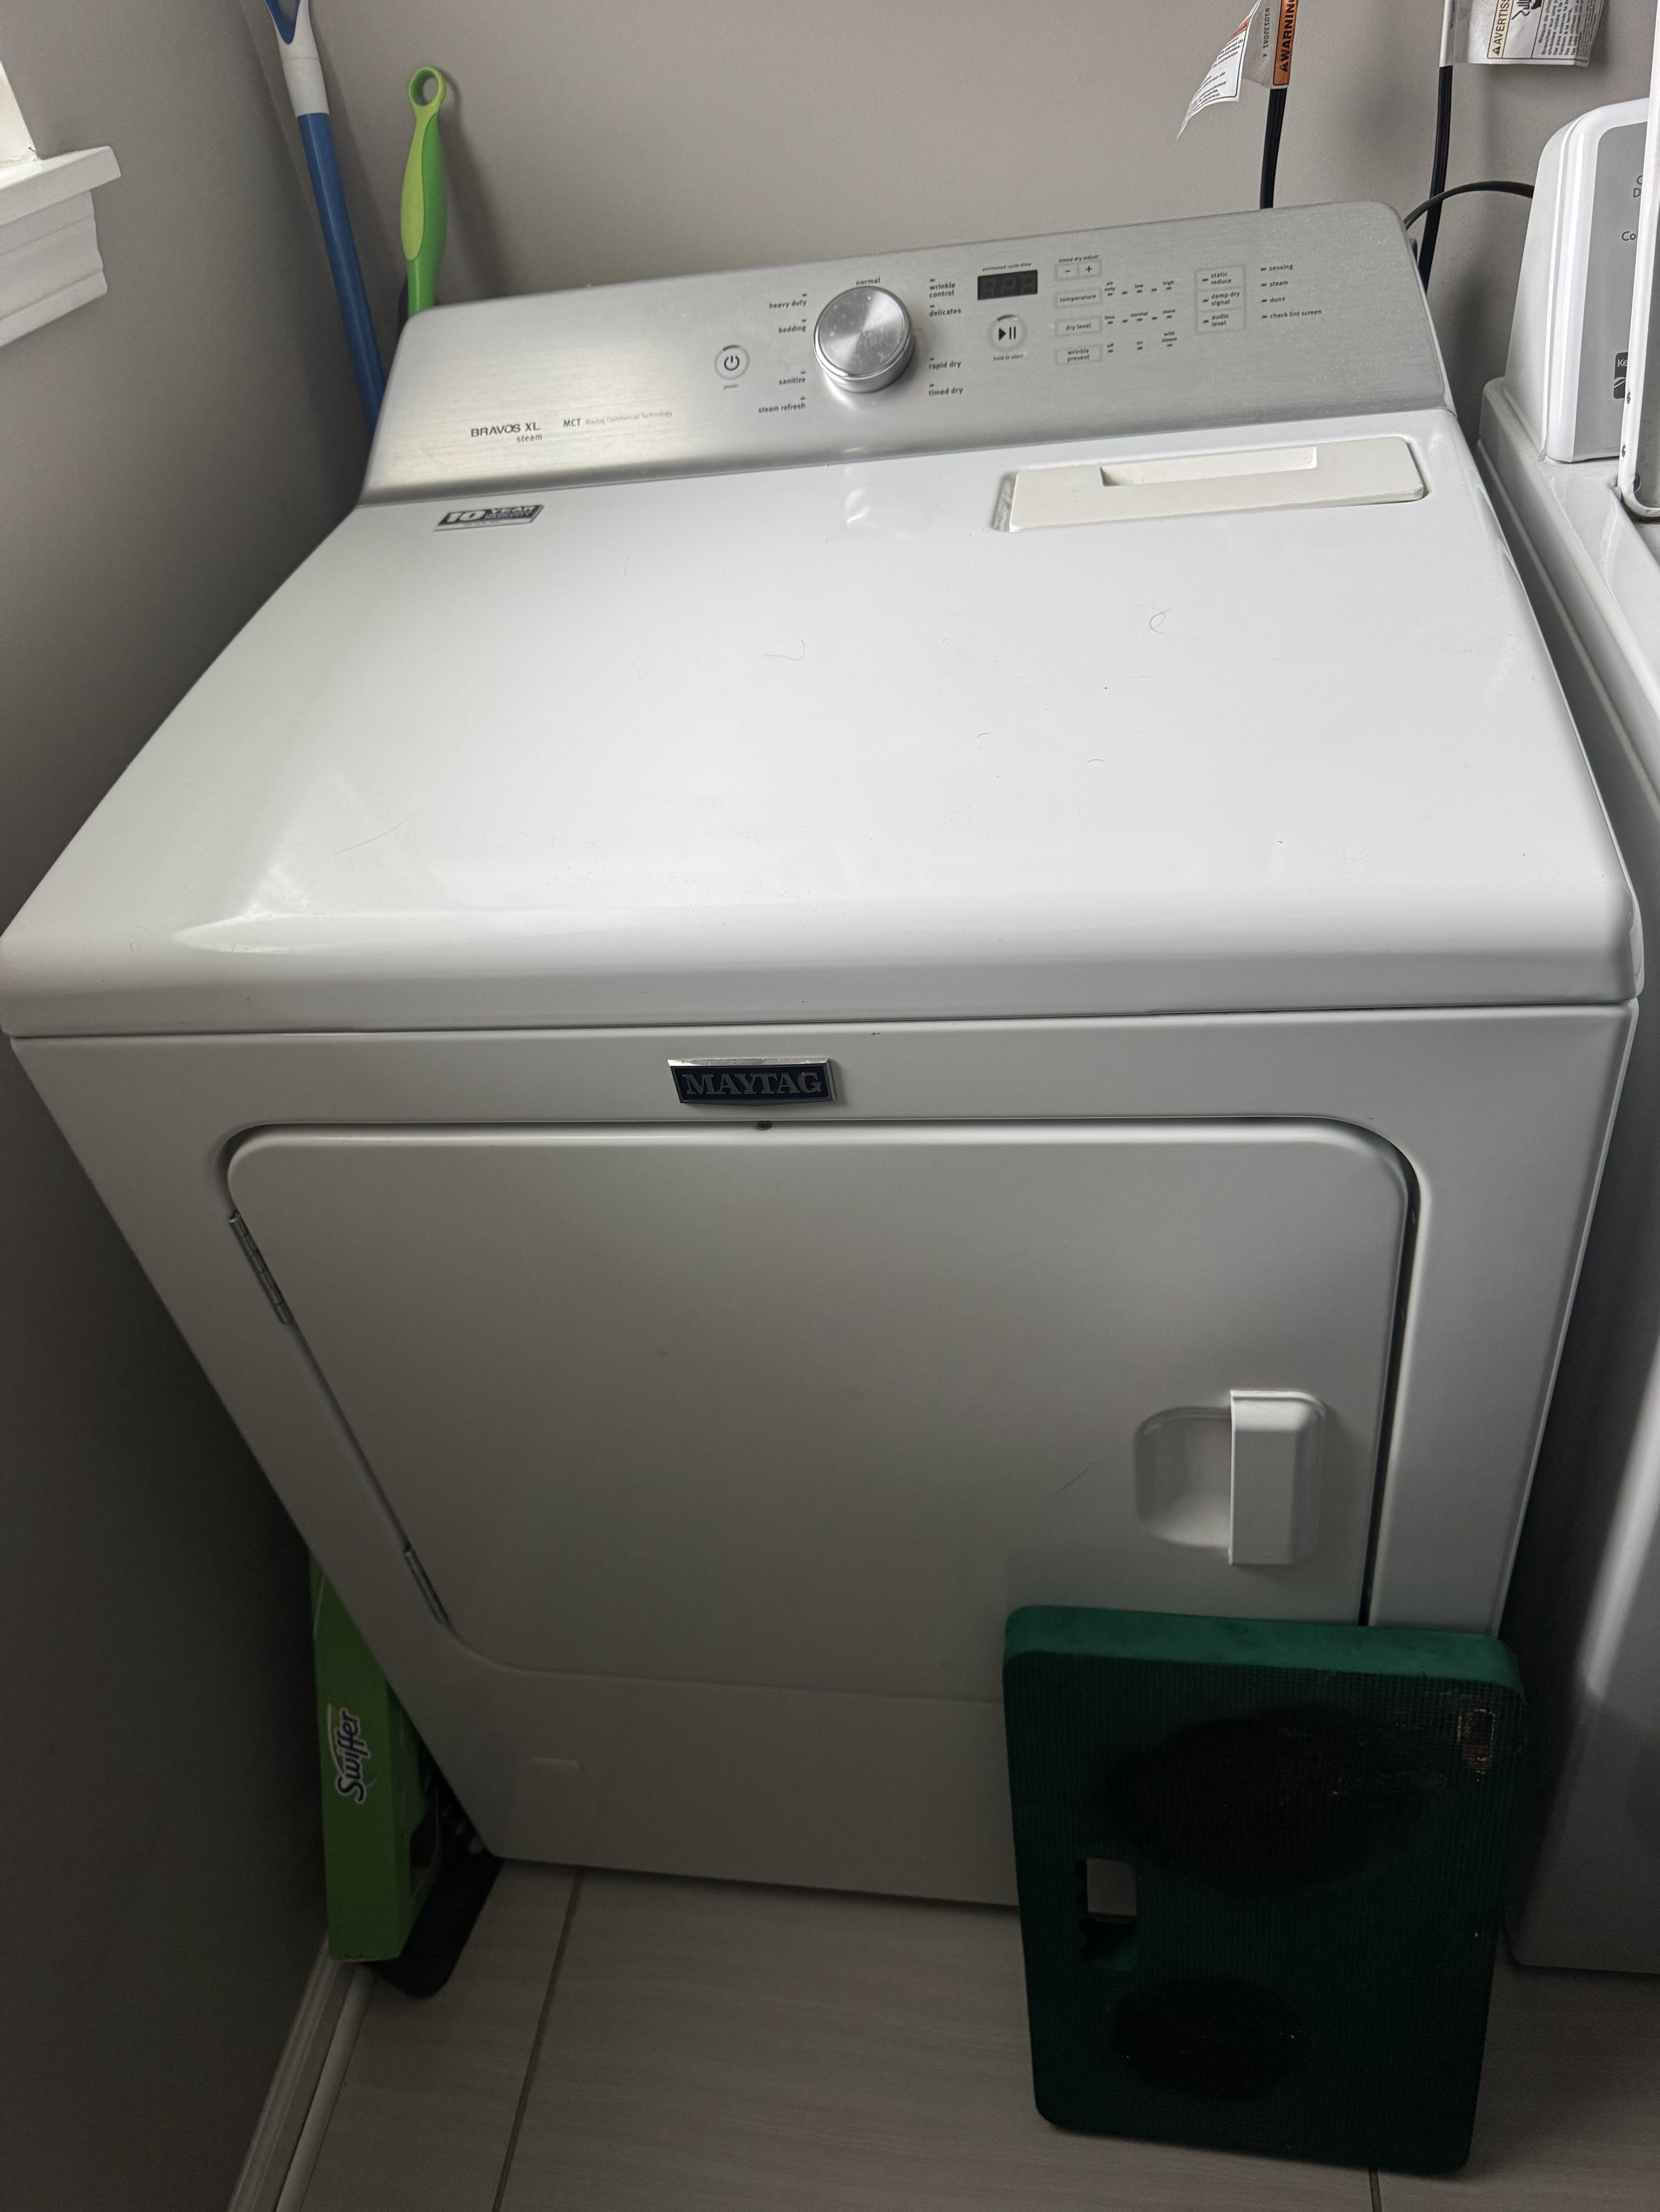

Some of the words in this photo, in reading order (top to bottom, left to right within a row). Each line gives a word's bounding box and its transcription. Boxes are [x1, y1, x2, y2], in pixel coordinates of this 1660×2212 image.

[1541, 29, 1551, 54] Brancher
[1622, 231, 1636, 241] Co
[856, 278, 881, 286] normal
[929, 282, 955, 291] wrinkle
[929, 290, 954, 298] control
[1059, 293, 1096, 303] temperature
[769, 301, 790, 310] heavy
[929, 308, 962, 317] delicates
[779, 325, 806, 334] bedding
[1067, 354, 1090, 363] prevent
[1617, 359, 1628, 367] Ke
[929, 361, 947, 370] rapid
[949, 361, 962, 369] dry
[779, 377, 806, 386] sanitize
[929, 388, 949, 397] timed
[951, 387, 963, 395] dry
[758, 405, 779, 414] steam
[781, 402, 806, 412] refresh
[563, 418, 582, 428] MCT
[607, 414, 640, 424] Commercial
[640, 411, 673, 419] Technology
[471, 424, 521, 438] BRAVOS
[525, 422, 541, 432] XL
[516, 434, 542, 443] steam
[446, 510, 486, 523] 10
[682, 1070, 822, 1095] MAYTAG
[336, 1709, 370, 1803] Swiffer
